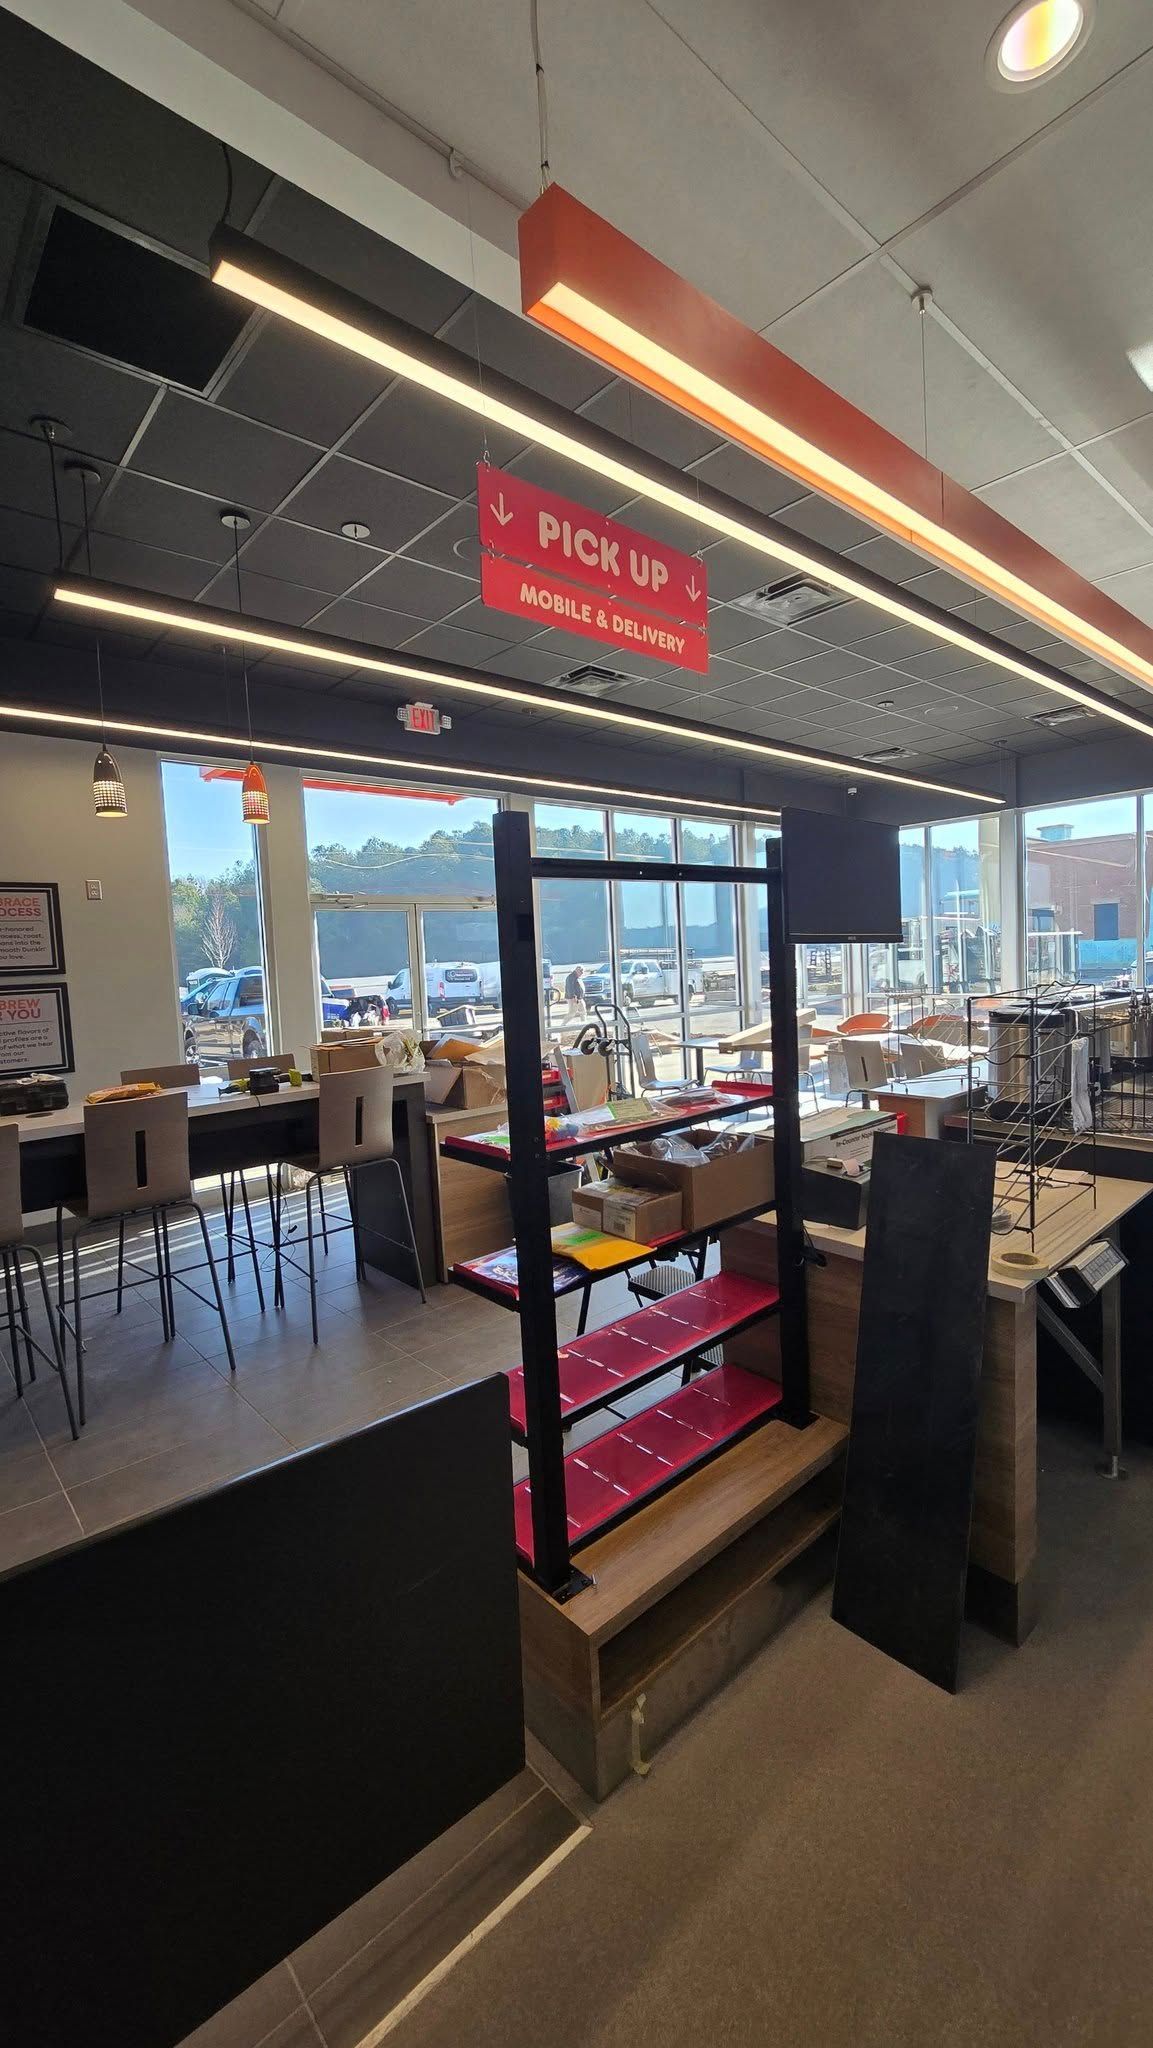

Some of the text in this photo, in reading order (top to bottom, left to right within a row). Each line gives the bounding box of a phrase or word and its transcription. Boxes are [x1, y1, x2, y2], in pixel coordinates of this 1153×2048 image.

[538, 510, 669, 593] PICK UP
[520, 582, 685, 655] MOBILE & DELIVERY
[411, 707, 436, 732] EXIT
[0, 999, 40, 1009] BREW
[7, 1008, 41, 1020] YOU
[3, 1036, 29, 1044] profiles
